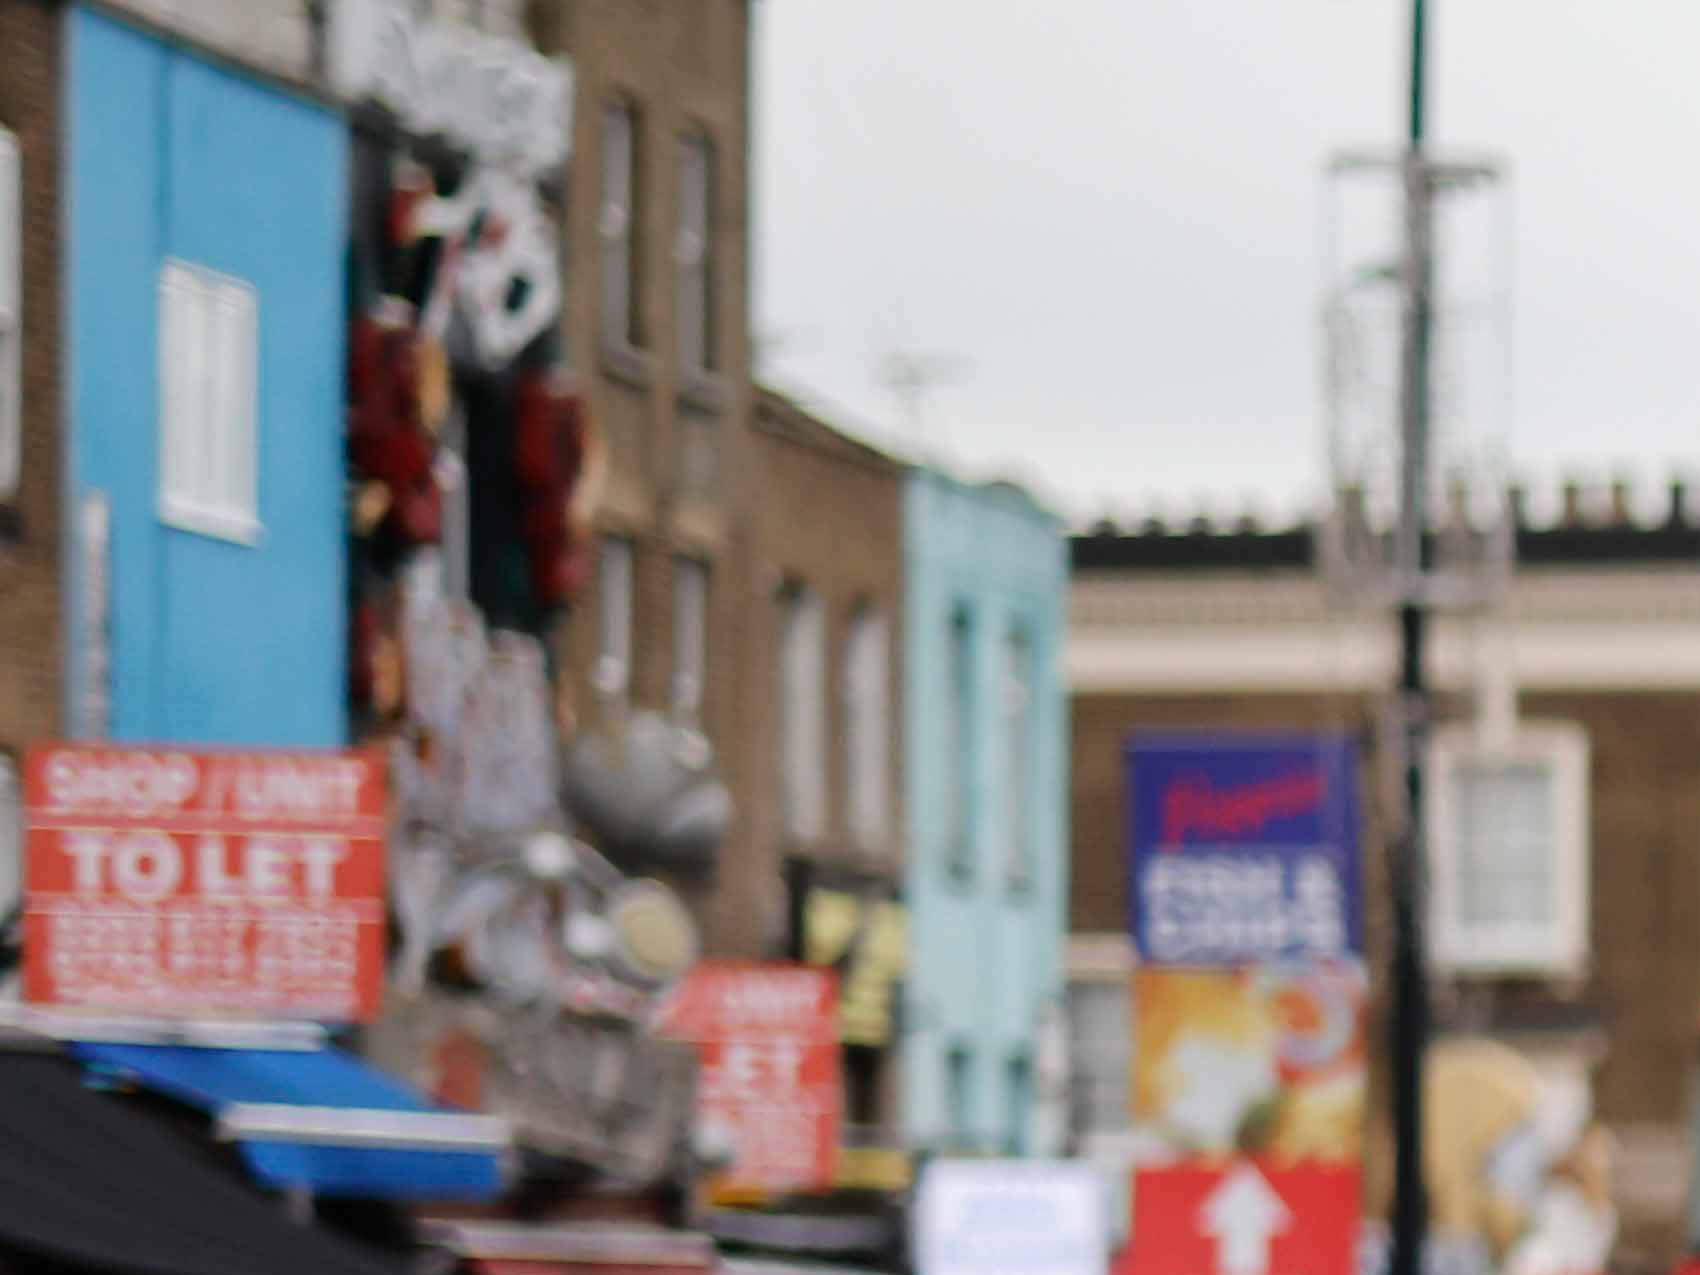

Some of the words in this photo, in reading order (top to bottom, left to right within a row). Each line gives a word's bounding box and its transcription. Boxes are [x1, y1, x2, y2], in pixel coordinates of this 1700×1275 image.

[43, 751, 198, 818] SHOP
[62, 827, 184, 903] TO
[197, 832, 350, 907] LET
